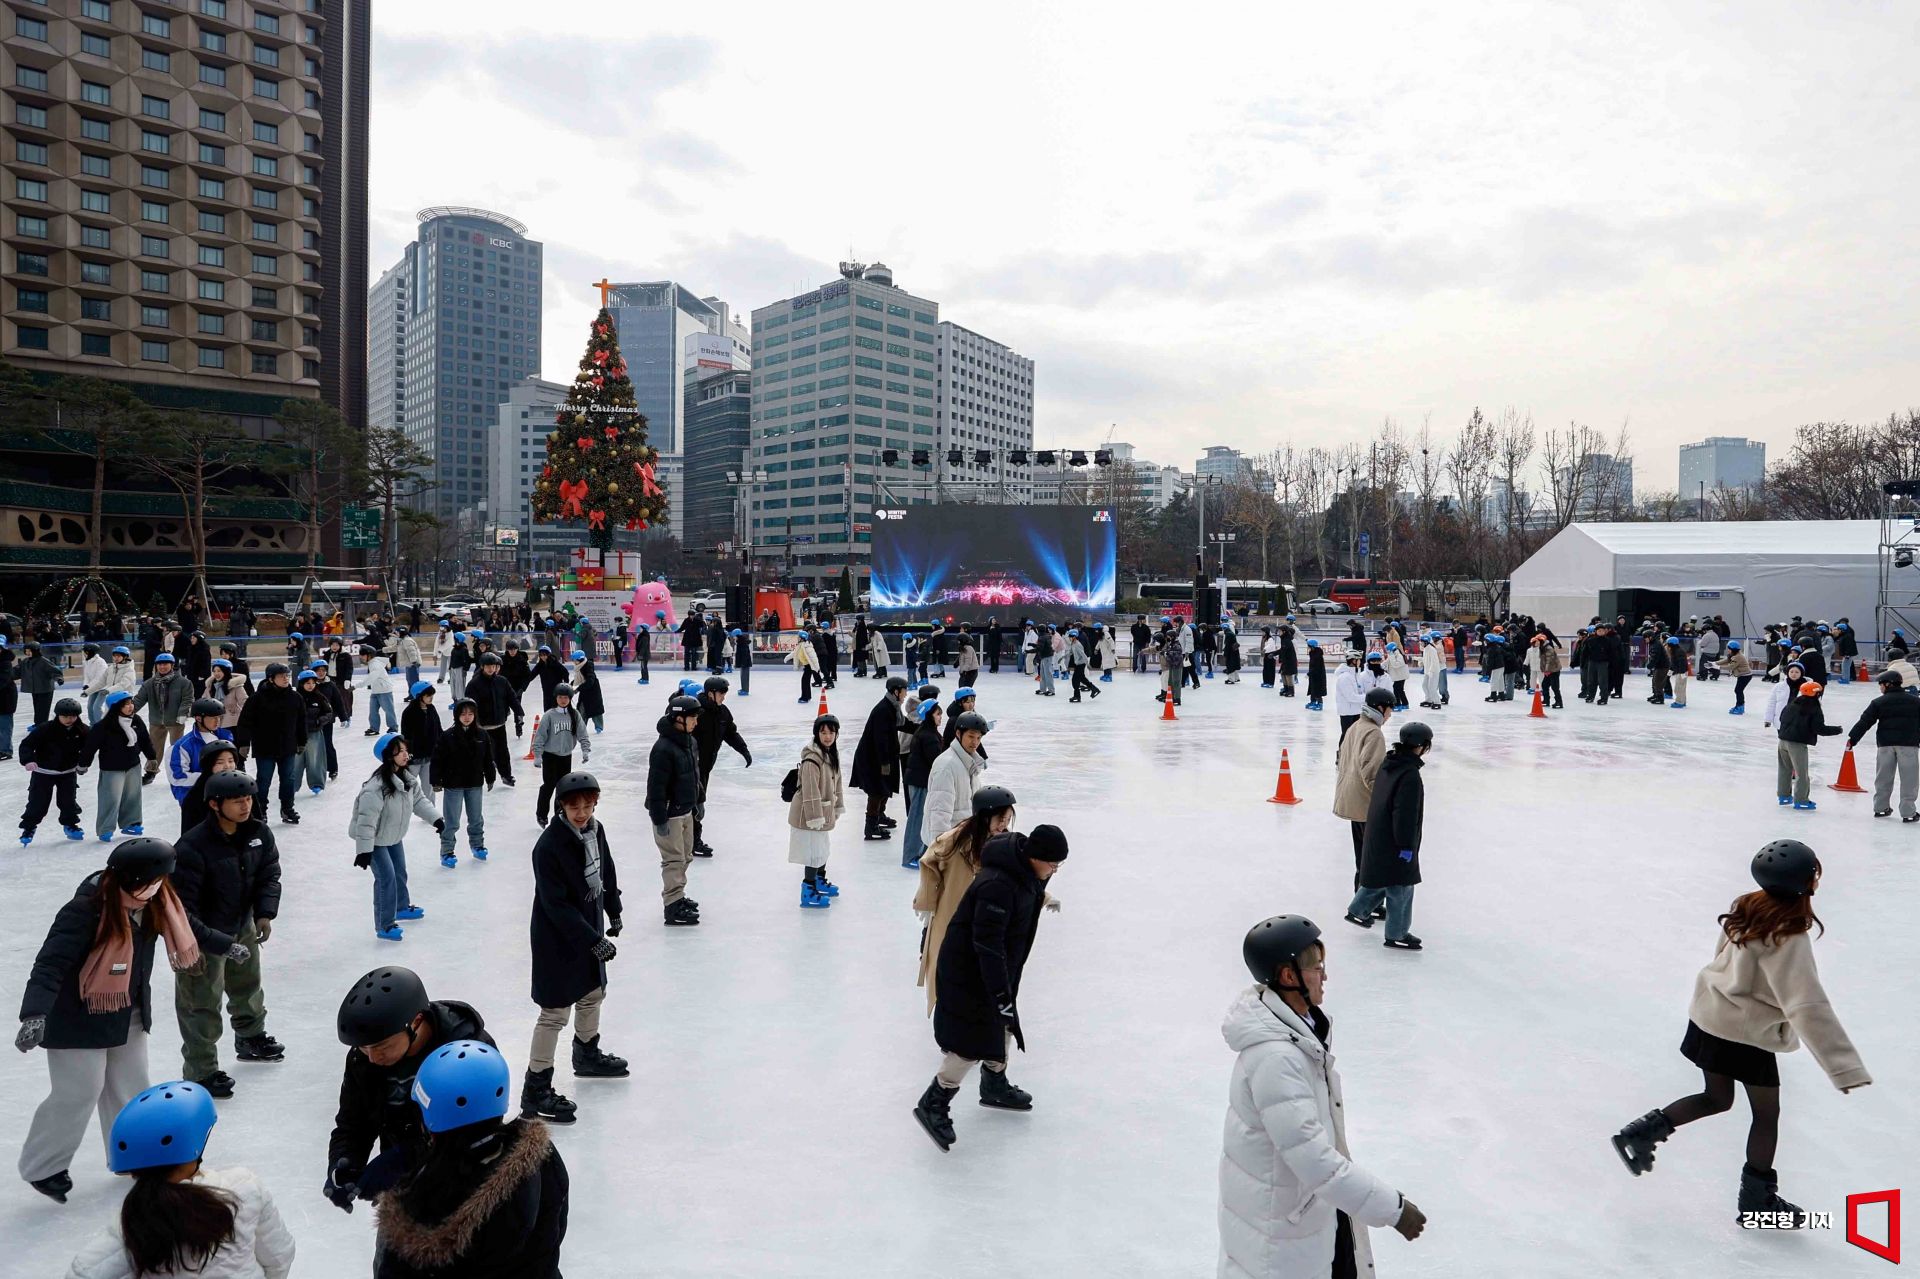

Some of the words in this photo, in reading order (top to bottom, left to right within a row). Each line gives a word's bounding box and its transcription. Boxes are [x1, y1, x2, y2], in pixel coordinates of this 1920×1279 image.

[489, 237, 512, 249] ICBC
[554, 403, 588, 414] Merry
[590, 403, 639, 413] Christmas
[595, 640, 616, 656] FESTA
